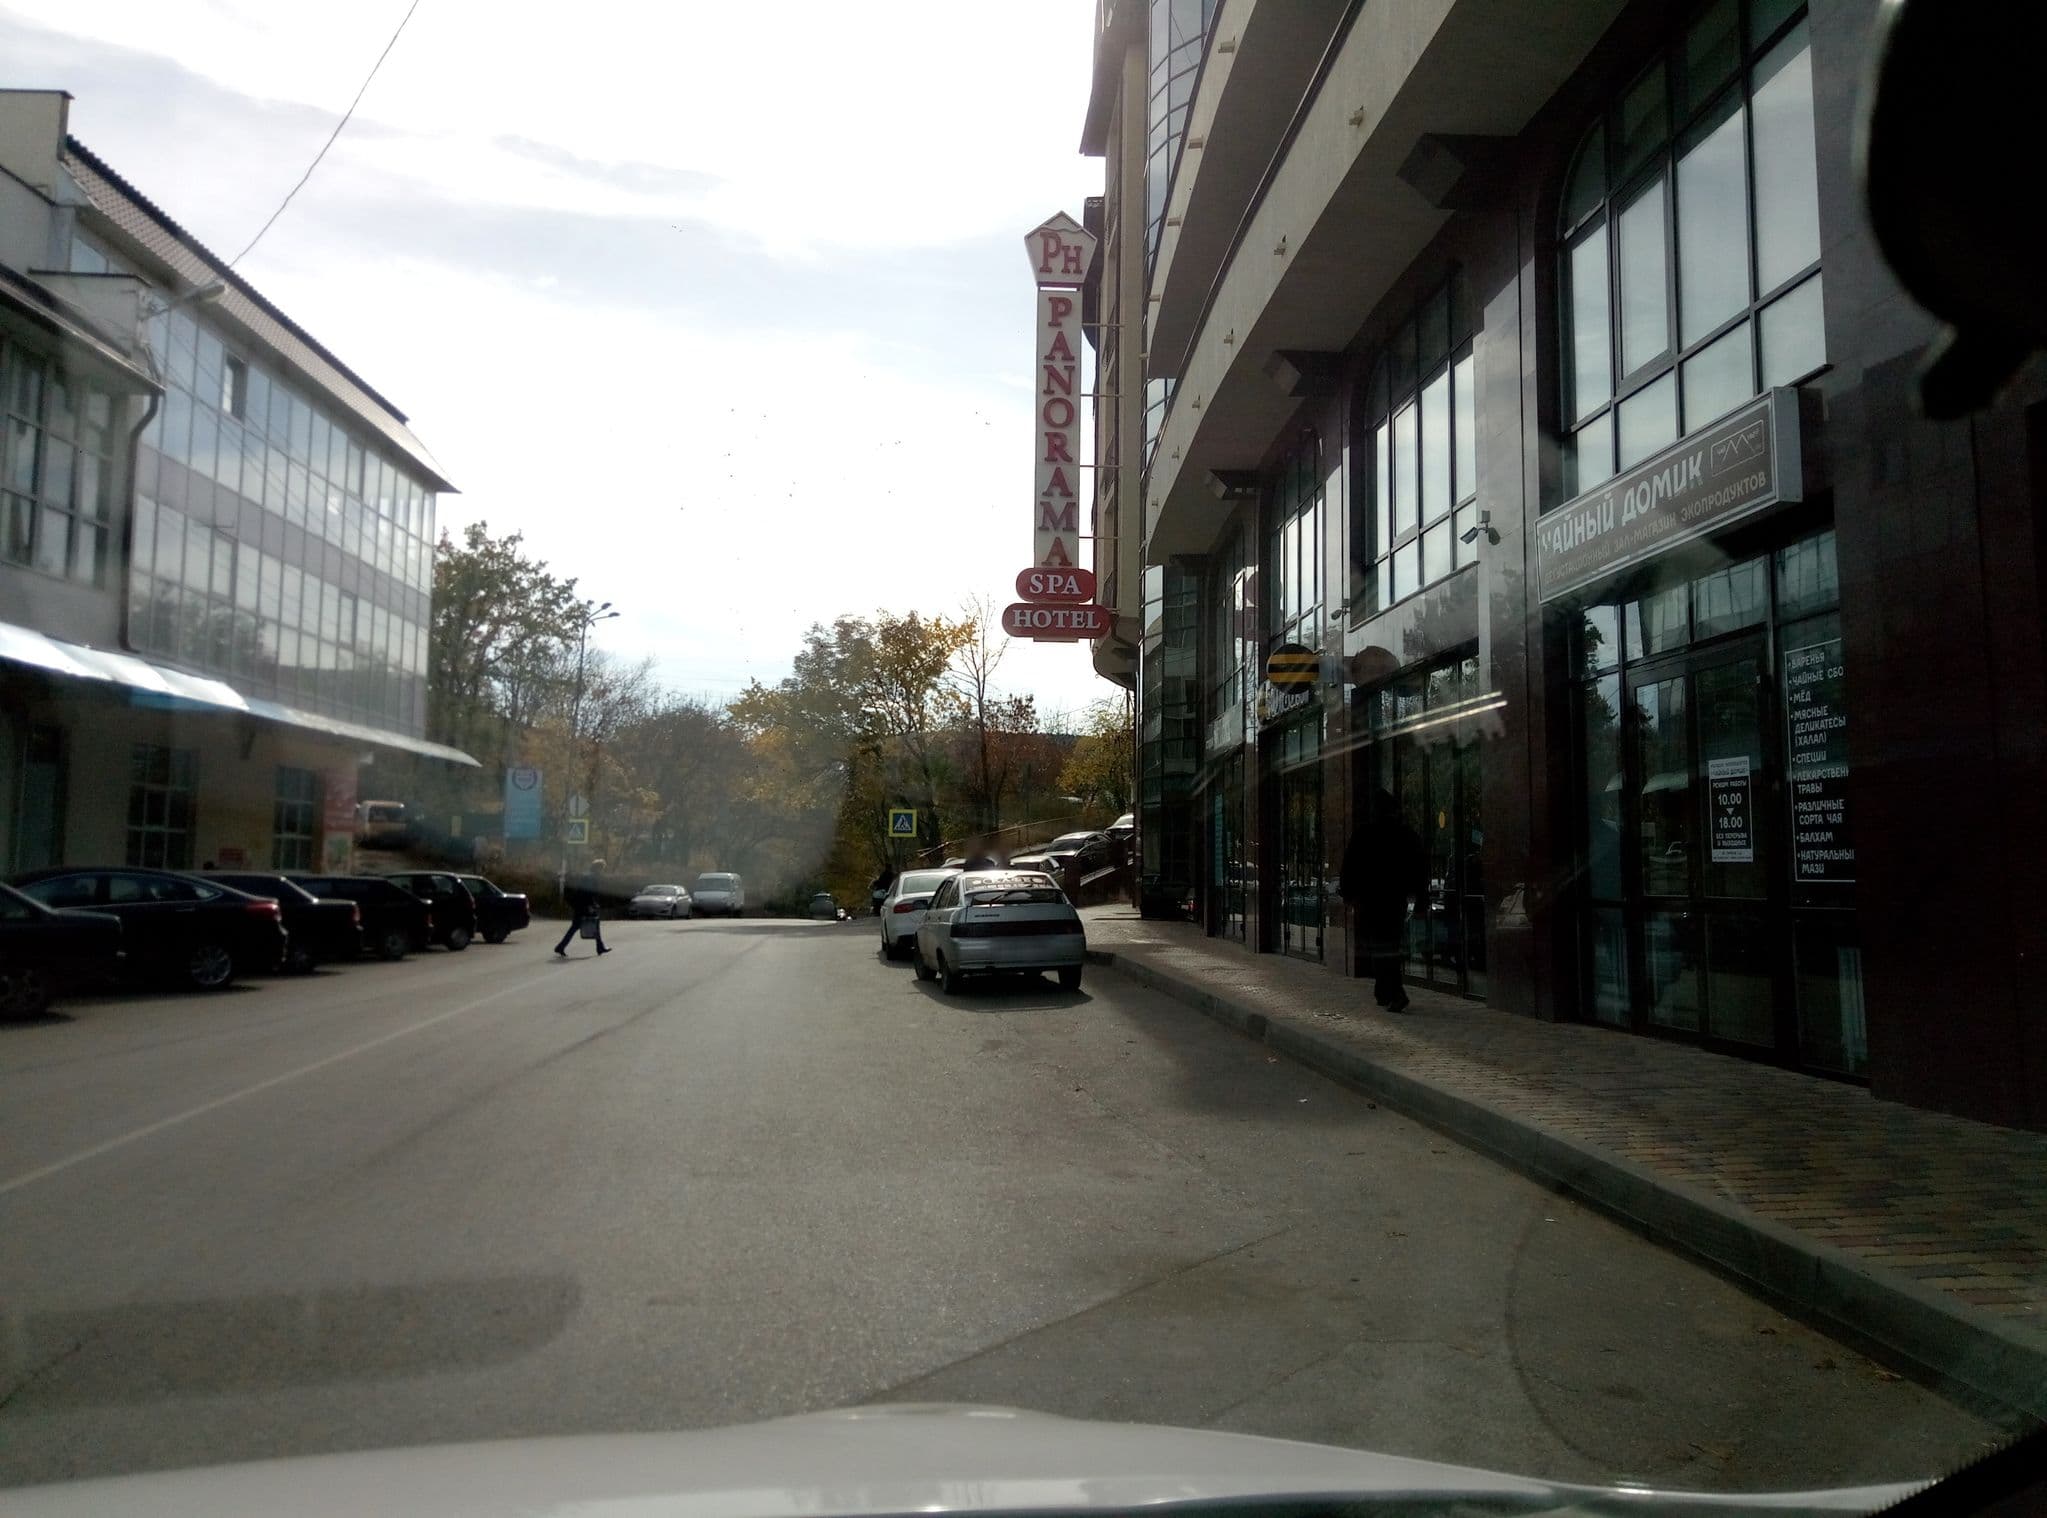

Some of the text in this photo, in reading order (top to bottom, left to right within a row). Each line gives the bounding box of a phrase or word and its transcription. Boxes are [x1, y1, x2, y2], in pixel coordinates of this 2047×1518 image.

[1039, 231, 1082, 274] PH
[1038, 296, 1077, 567] PANORAMA
[1622, 451, 1704, 525] ДОМИК
[1681, 471, 1766, 523] ЭКОПРОДУКТОВ
[1029, 573, 1082, 596] SPA
[1013, 610, 1101, 630] HOTEL
[1792, 670, 1824, 687] ЧАЙНЫЕ
[1793, 691, 1811, 703] МЁД
[1794, 705, 1829, 721] МЯСНЫЕ
[1794, 715, 1846, 734] ДЕЛИКАТЕСЫ
[1795, 732, 1827, 747] (ХАЛАЛ)
[1796, 750, 1826, 764] СПЕЦИИ
[1798, 783, 1823, 794] ТРАВЫ
[1718, 793, 1742, 805] 10.00
[1798, 799, 1845, 812] РАЗЛИЧНЫЕ
[1719, 816, 1743, 828] 18.00
[1799, 813, 1843, 825] СОРТА ЧАЯ
[1801, 863, 1824, 874] МАЗИ
